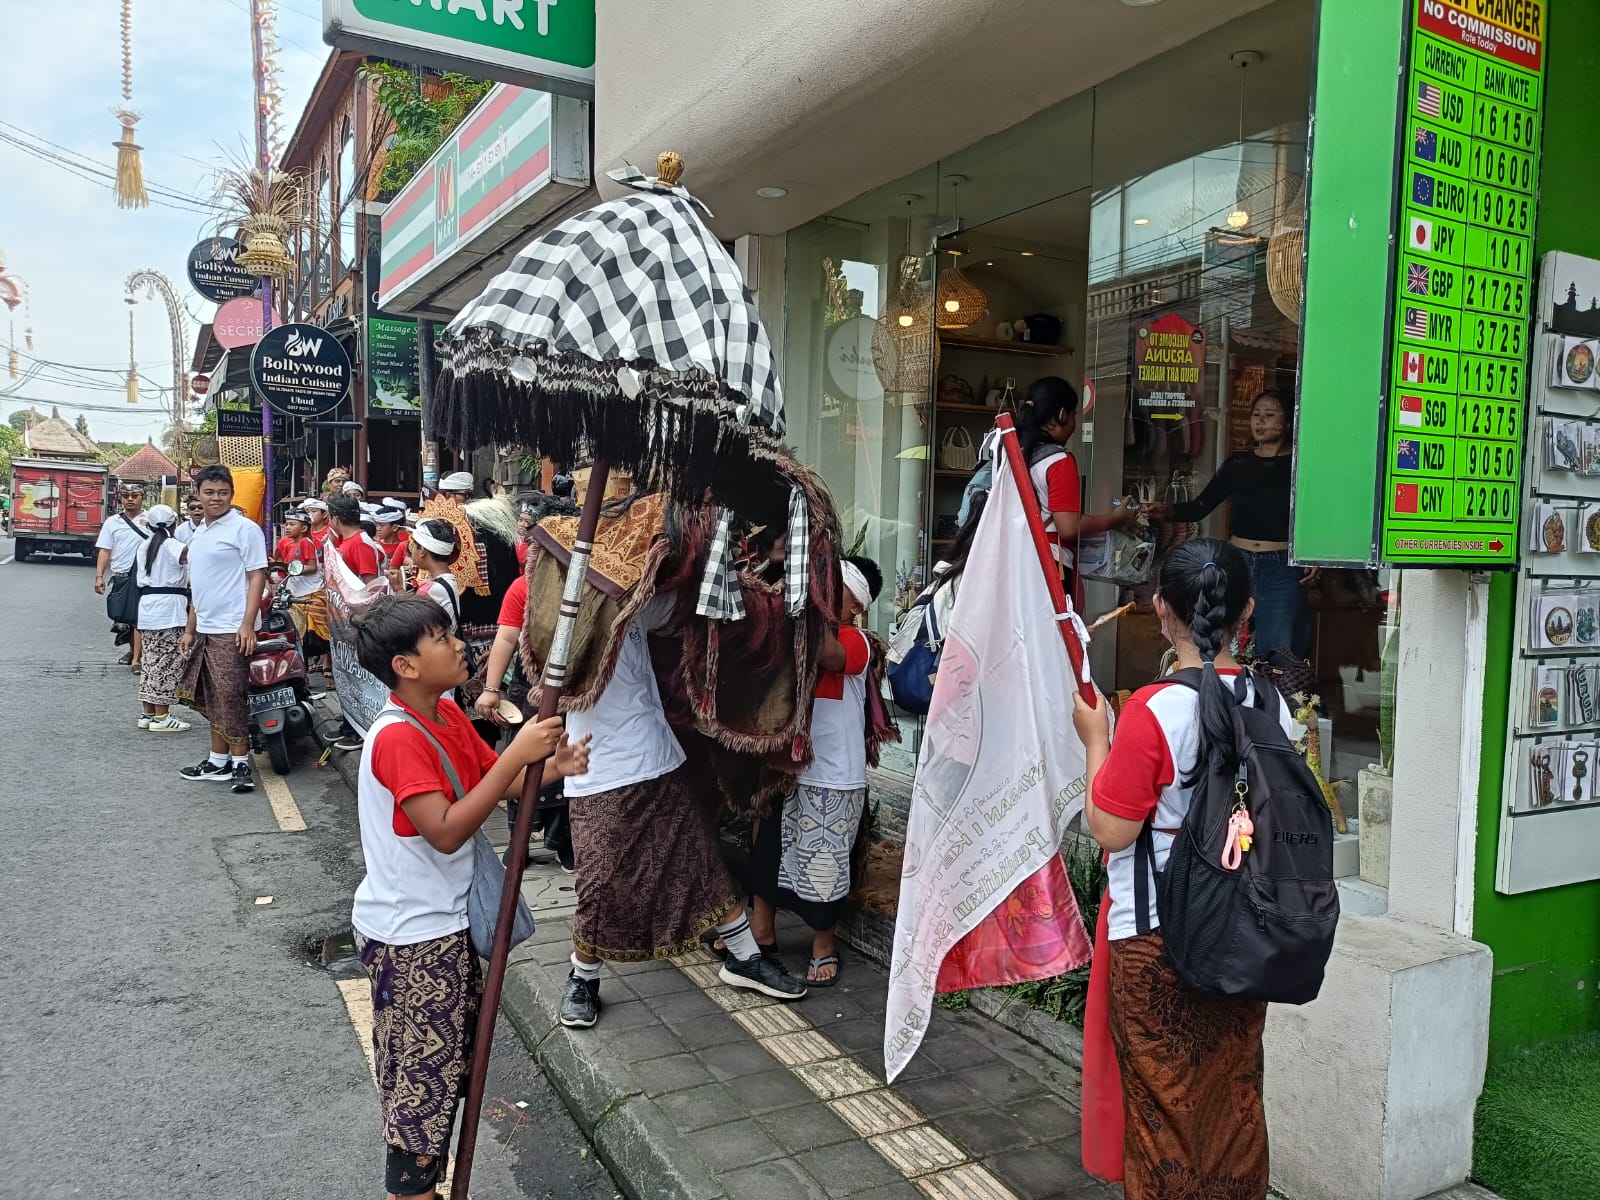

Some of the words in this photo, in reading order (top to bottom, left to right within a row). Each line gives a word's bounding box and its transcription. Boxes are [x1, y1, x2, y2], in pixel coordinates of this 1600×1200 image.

[410, 0, 558, 36] ART
[1423, 0, 1443, 19] NO
[1448, 10, 1537, 55] COMMISSION
[1461, 30, 1477, 45] Rate
[1477, 36, 1497, 53] Today
[1424, 43, 1467, 82] CURRENCY
[1484, 66, 1506, 93] BANK
[1508, 76, 1529, 103] NOTE
[1442, 92, 1464, 124] USD
[1479, 102, 1533, 147] 16150
[1439, 139, 1462, 169] AUD
[1475, 146, 1529, 189] 10600
[1437, 180, 1465, 214] EURO
[1473, 195, 1528, 231] 19025
[1433, 226, 1455, 256] JPY
[1490, 237, 1522, 272] 101
[195, 261, 247, 274] Bollywoo
[195, 272, 221, 281] Indian
[224, 275, 254, 285] Cuisine
[1432, 269, 1453, 299] GBP
[1466, 276, 1523, 314] 21725
[220, 325, 263, 336] SECRE
[376, 322, 411, 335] Massage
[1429, 313, 1452, 343] MYR
[1477, 319, 1521, 354] 3725
[263, 356, 342, 377] Bollywood
[263, 373, 298, 385] Indian
[302, 377, 342, 389] Cuisine
[1427, 356, 1449, 385] CAD
[1463, 359, 1518, 396] 11575
[291, 396, 314, 405] Ubud
[1425, 400, 1447, 427] SGD
[1461, 403, 1516, 436] 12375
[1422, 443, 1445, 470] NZD
[1469, 444, 1514, 477] 9050
[1421, 486, 1444, 512] CNY
[1466, 487, 1510, 517] 2200
[1395, 539, 1418, 550] OTHER
[1420, 540, 1461, 550] CURRENCIES
[1463, 540, 1484, 551] INSIDE
